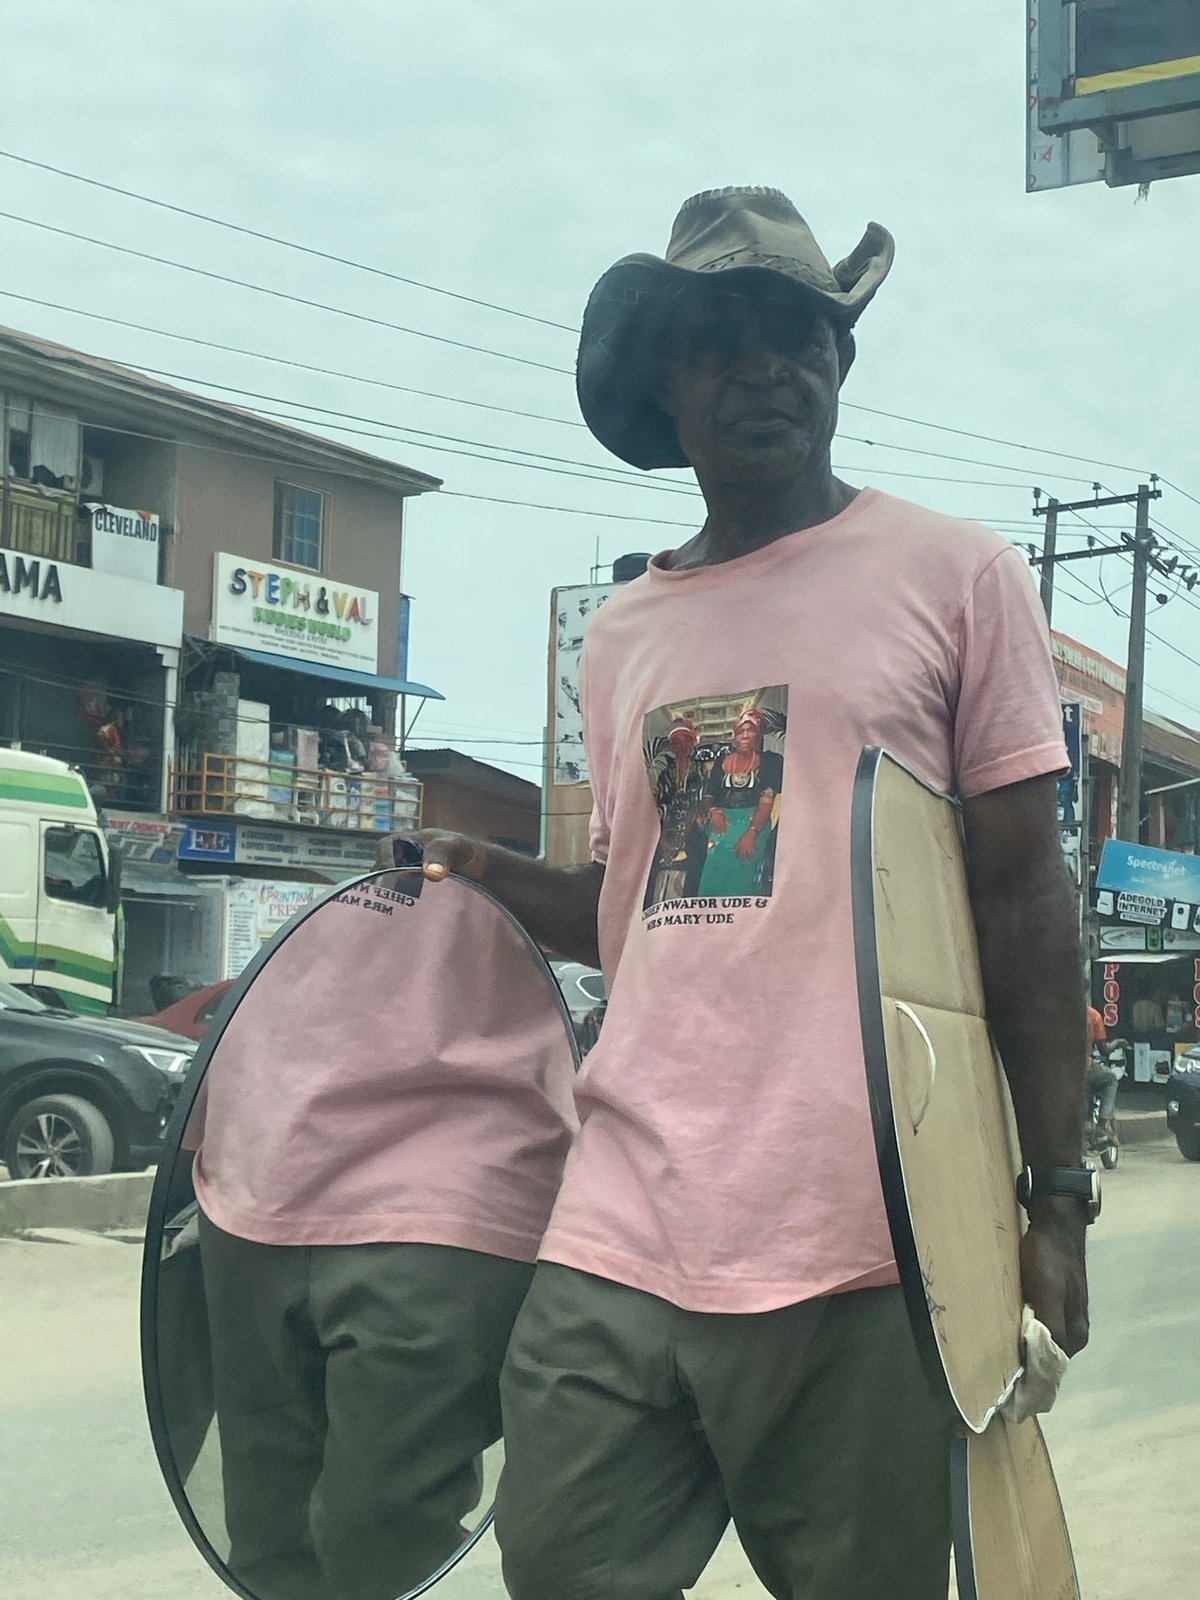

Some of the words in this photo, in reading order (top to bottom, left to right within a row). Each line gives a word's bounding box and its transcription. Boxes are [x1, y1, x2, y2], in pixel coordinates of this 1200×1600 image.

[95, 510, 157, 541] CLEVELAND
[229, 567, 310, 612] STEPH
[315, 586, 330, 616] &
[332, 590, 373, 626] VAL
[1127, 855, 1186, 876] Spectranet
[661, 898, 717, 912] NWAFOR
[721, 898, 752, 908] UDE
[755, 899, 768, 908] &
[1120, 892, 1164, 907] ADEGOLD
[1119, 902, 1166, 916] INTERNET
[663, 914, 702, 926] MARY
[705, 913, 735, 924] UDE
[1104, 963, 1120, 1027] POS
